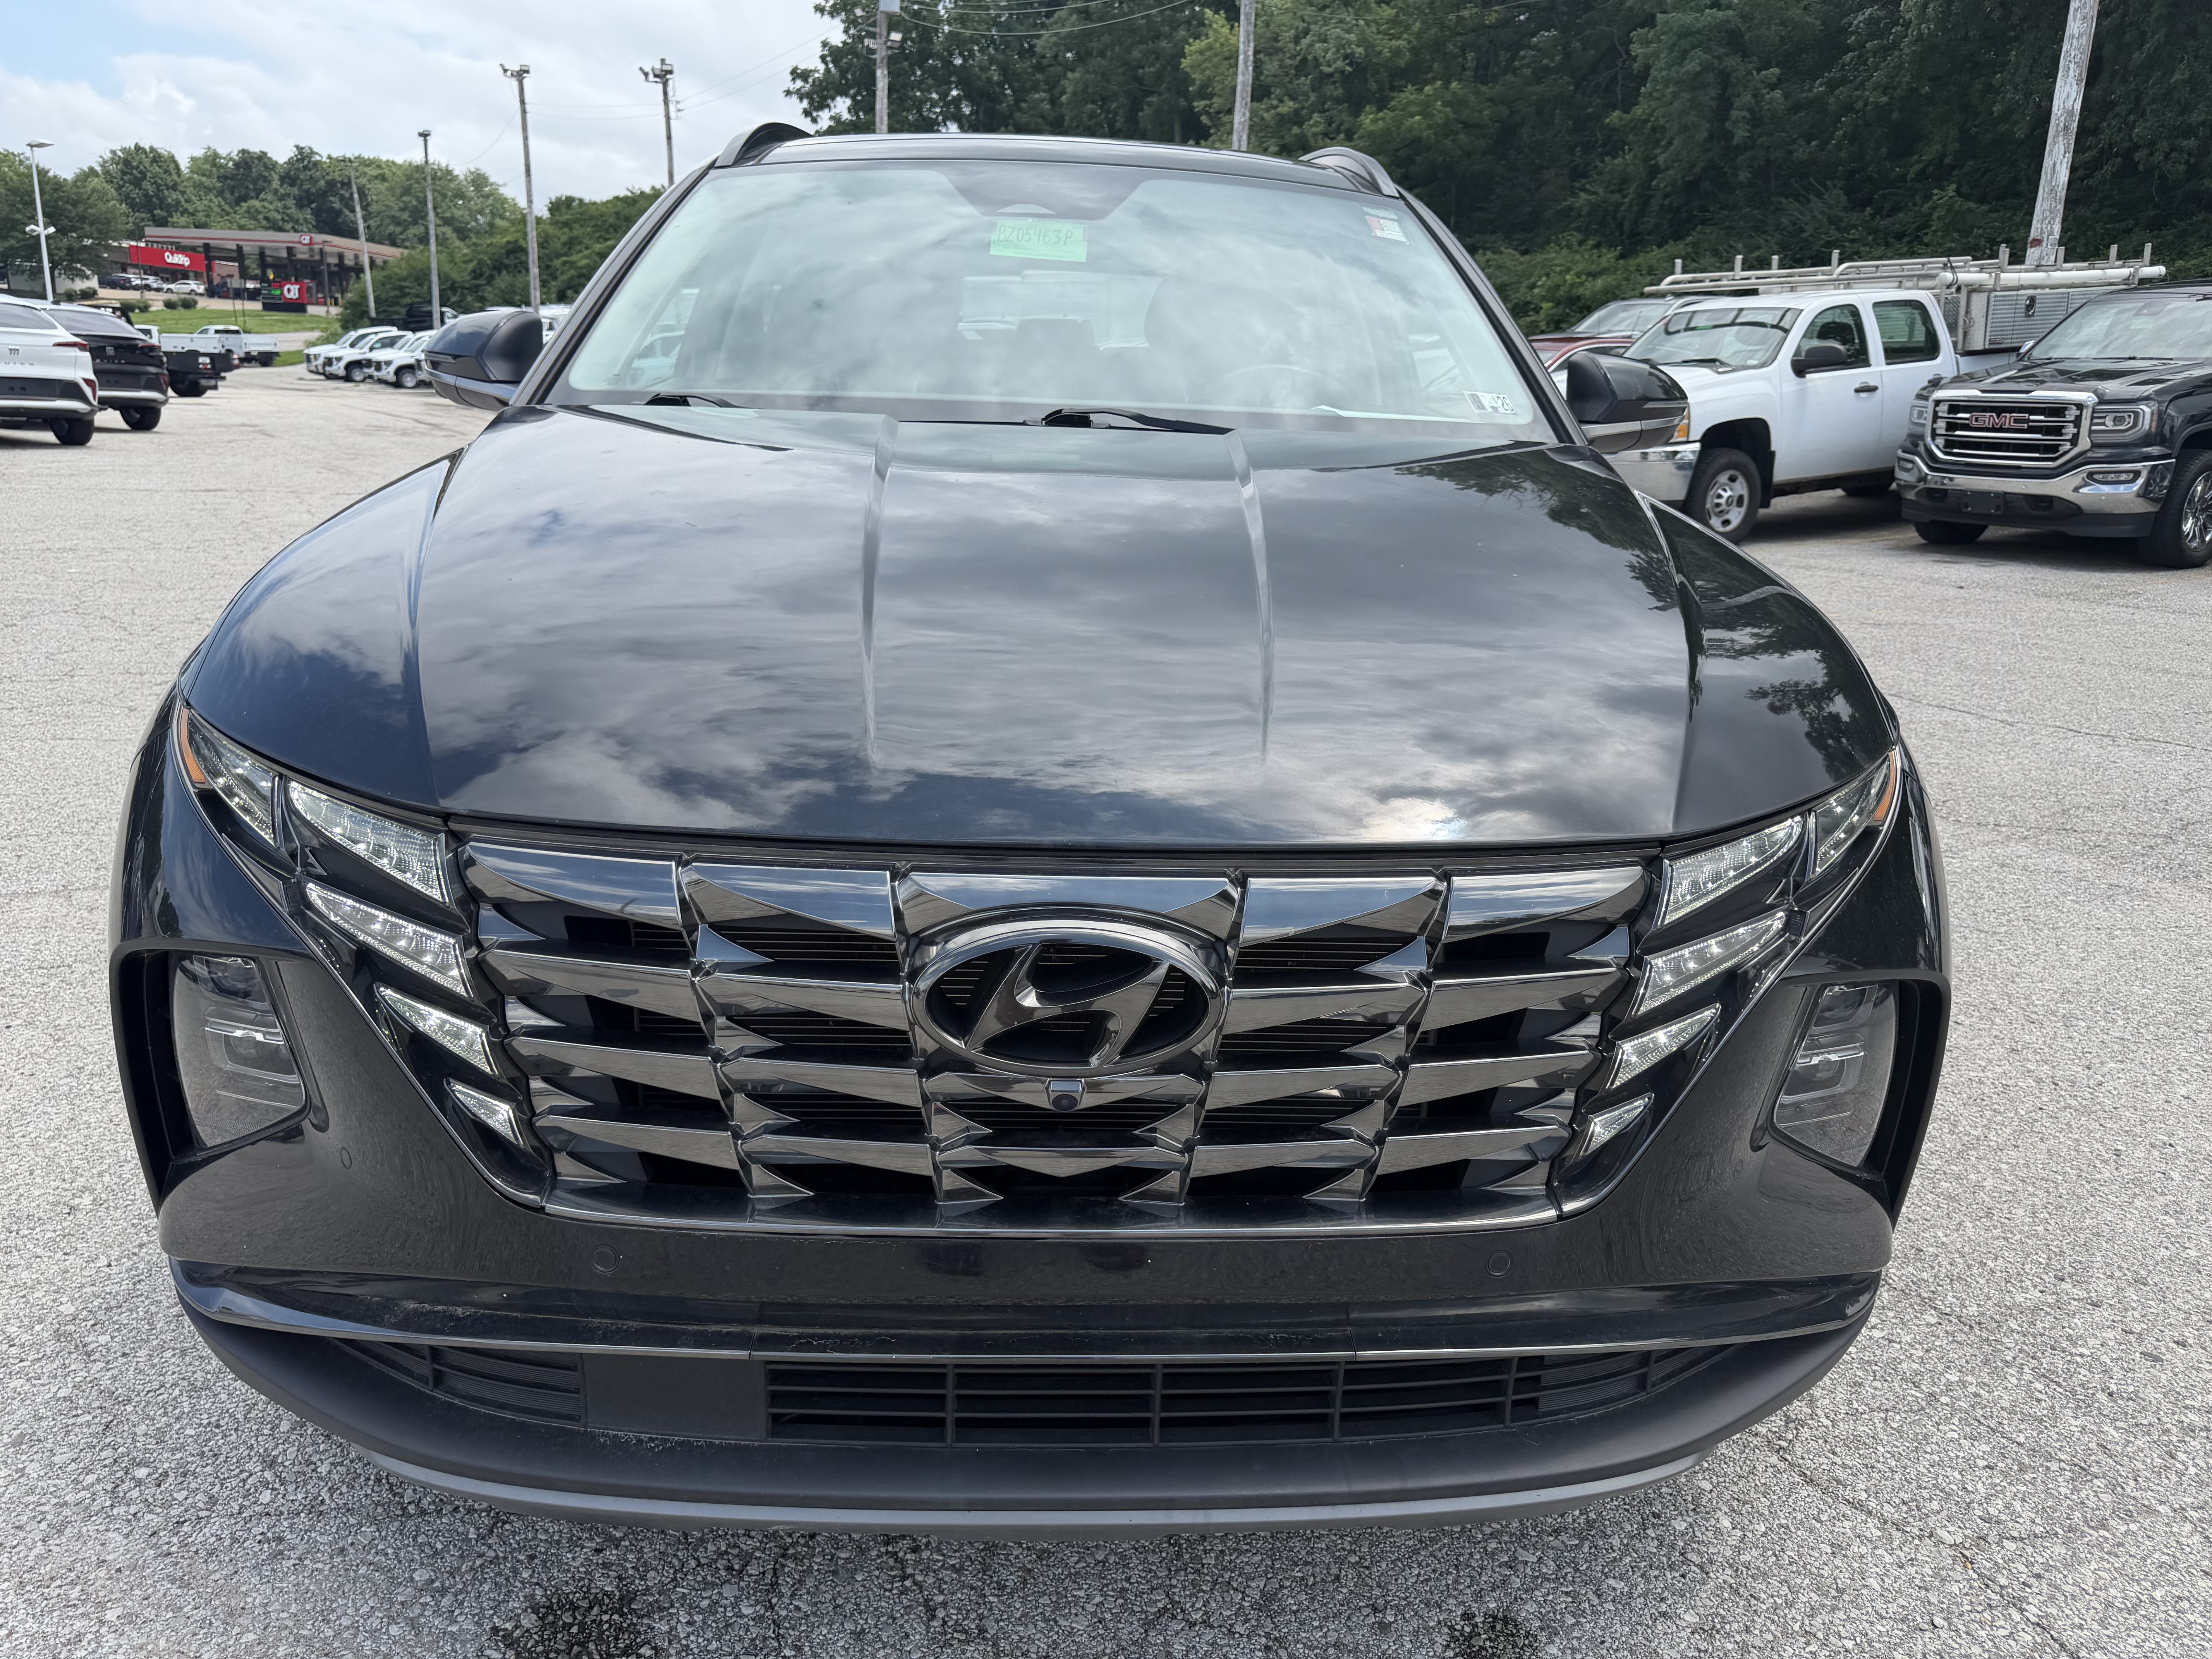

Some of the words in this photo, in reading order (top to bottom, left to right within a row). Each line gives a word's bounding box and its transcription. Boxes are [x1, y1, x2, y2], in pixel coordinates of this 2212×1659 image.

[998, 225, 1073, 246] BZ05463P
[284, 284, 300, 299] QT
[1496, 396, 1514, 411] 26
[1969, 412, 2029, 429] GMC
